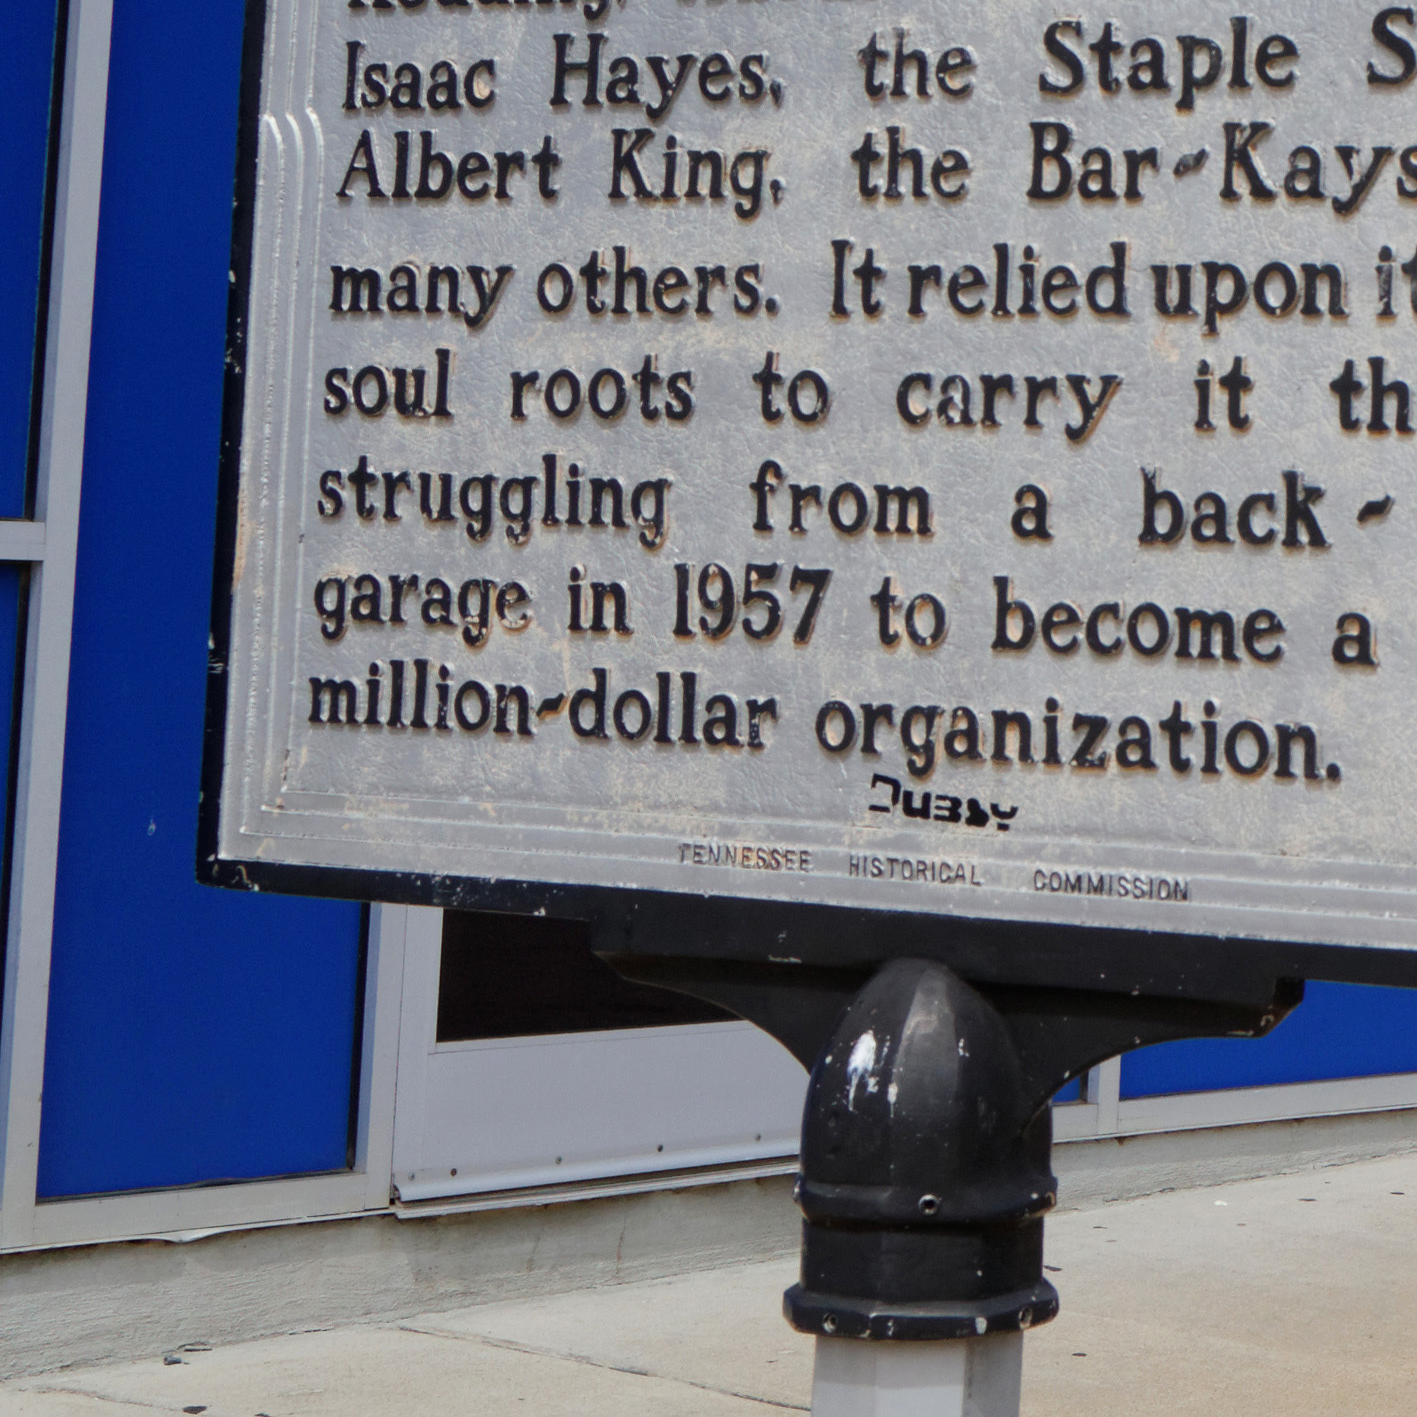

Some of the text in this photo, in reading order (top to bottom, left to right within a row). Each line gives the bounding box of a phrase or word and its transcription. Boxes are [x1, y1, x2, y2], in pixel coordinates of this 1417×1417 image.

[342, 41, 497, 111] Isaac
[550, 33, 784, 118] Hayes,
[858, 27, 976, 98] the
[1038, 16, 1299, 110] Staple
[336, 130, 561, 201] Albert
[608, 127, 786, 218] King,
[851, 126, 972, 199] the
[329, 260, 513, 326] many
[536, 246, 780, 316] others.
[831, 238, 883, 318] It
[907, 240, 1130, 318] relied
[1153, 255, 1349, 334] upon
[324, 348, 454, 417] soul
[510, 351, 696, 420] roots
[752, 351, 832, 423] to
[896, 368, 1123, 442] carry
[1193, 356, 1254, 430] it
[317, 454, 674, 550] struggling
[750, 460, 934, 536] from
[1010, 482, 1053, 540] a
[313, 572, 532, 644] garage
[567, 564, 634, 636] in
[673, 562, 831, 644] 1957
[870, 575, 949, 649] to
[991, 575, 1286, 663] become
[1332, 609, 1379, 666] a
[308, 660, 1343, 781] million-dollar organization.
[678, 842, 1192, 902] TENNESSEE HISTORICAL COMMISSION
